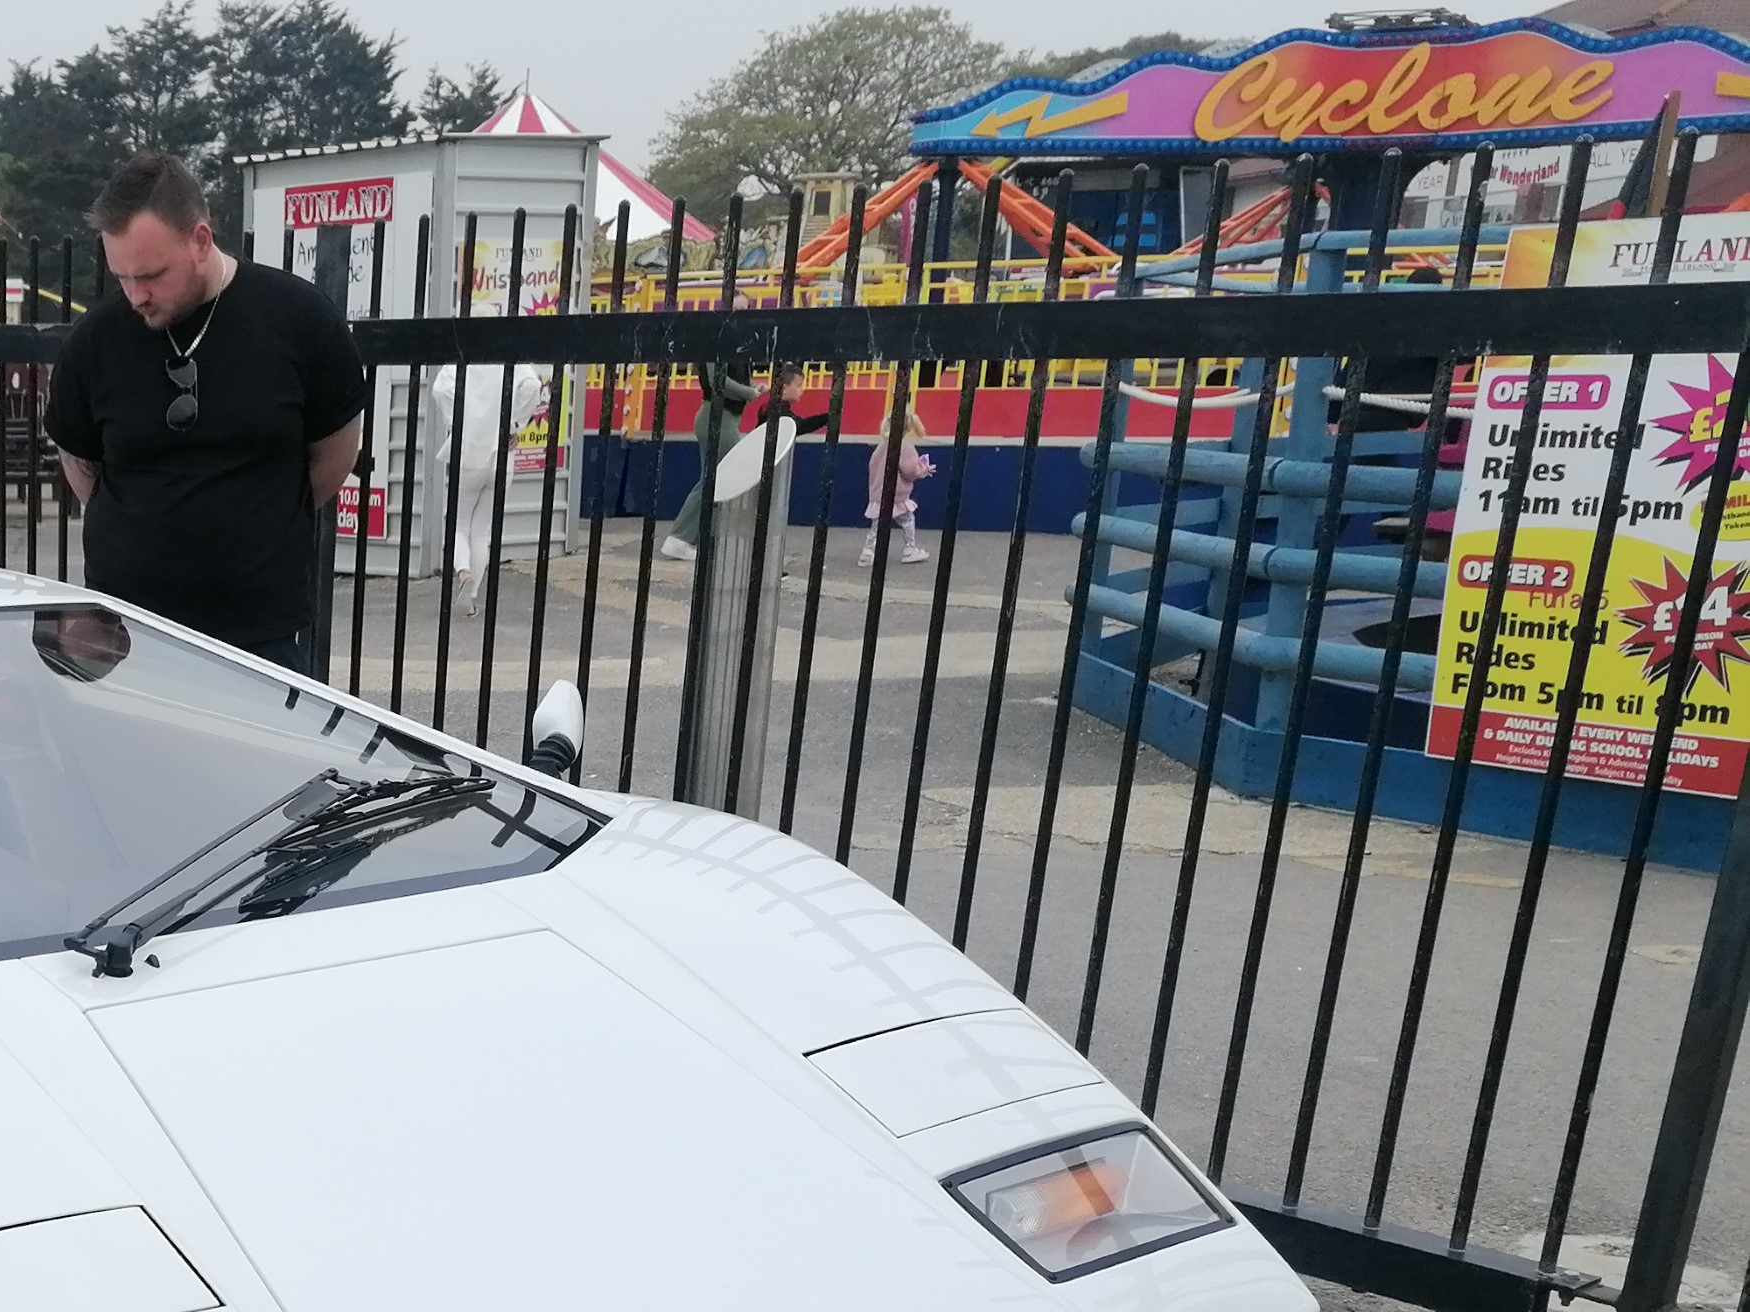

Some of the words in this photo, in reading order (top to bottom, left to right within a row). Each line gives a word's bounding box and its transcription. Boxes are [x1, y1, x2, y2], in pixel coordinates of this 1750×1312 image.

[1194, 43, 1614, 142] Cyclone
[1499, 156, 1560, 186] Wonderland
[286, 185, 392, 225] FUNLAND
[296, 234, 376, 266] Ament
[495, 247, 543, 259] FUAND
[1609, 237, 1750, 268] FULAN
[469, 261, 560, 292] Wrisand
[1492, 381, 1580, 403] OFER
[1588, 382, 1603, 403] 1
[1488, 423, 1646, 449] Unimite
[1481, 456, 1566, 482] Ries
[338, 489, 382, 507] 10.0m
[1571, 495, 1600, 517] til
[1462, 560, 1545, 584] OFER
[1551, 566, 1569, 587] 2
[1652, 586, 1733, 632] £4
[1459, 610, 1610, 645] Ulimitd
[1455, 642, 1536, 670] Rdes
[1694, 642, 1714, 650] DAY
[1451, 673, 1526, 702] Fom
[1537, 681, 1604, 713] 5m
[1616, 694, 1644, 715] til
[1483, 728, 1494, 739] &
[1496, 729, 1535, 745] DAILY
[1535, 734, 1586, 752] DUNG
[1590, 741, 1644, 760] SCHOOL
[1648, 748, 1720, 769] LIDAYS
[1579, 725, 1625, 743] EVERY
[1627, 732, 1699, 751] WEEND
[1508, 743, 1542, 757] Excludes
[1607, 757, 1650, 771] Adventur
[1594, 766, 1626, 779] Subject
[1626, 770, 1637, 779] to
